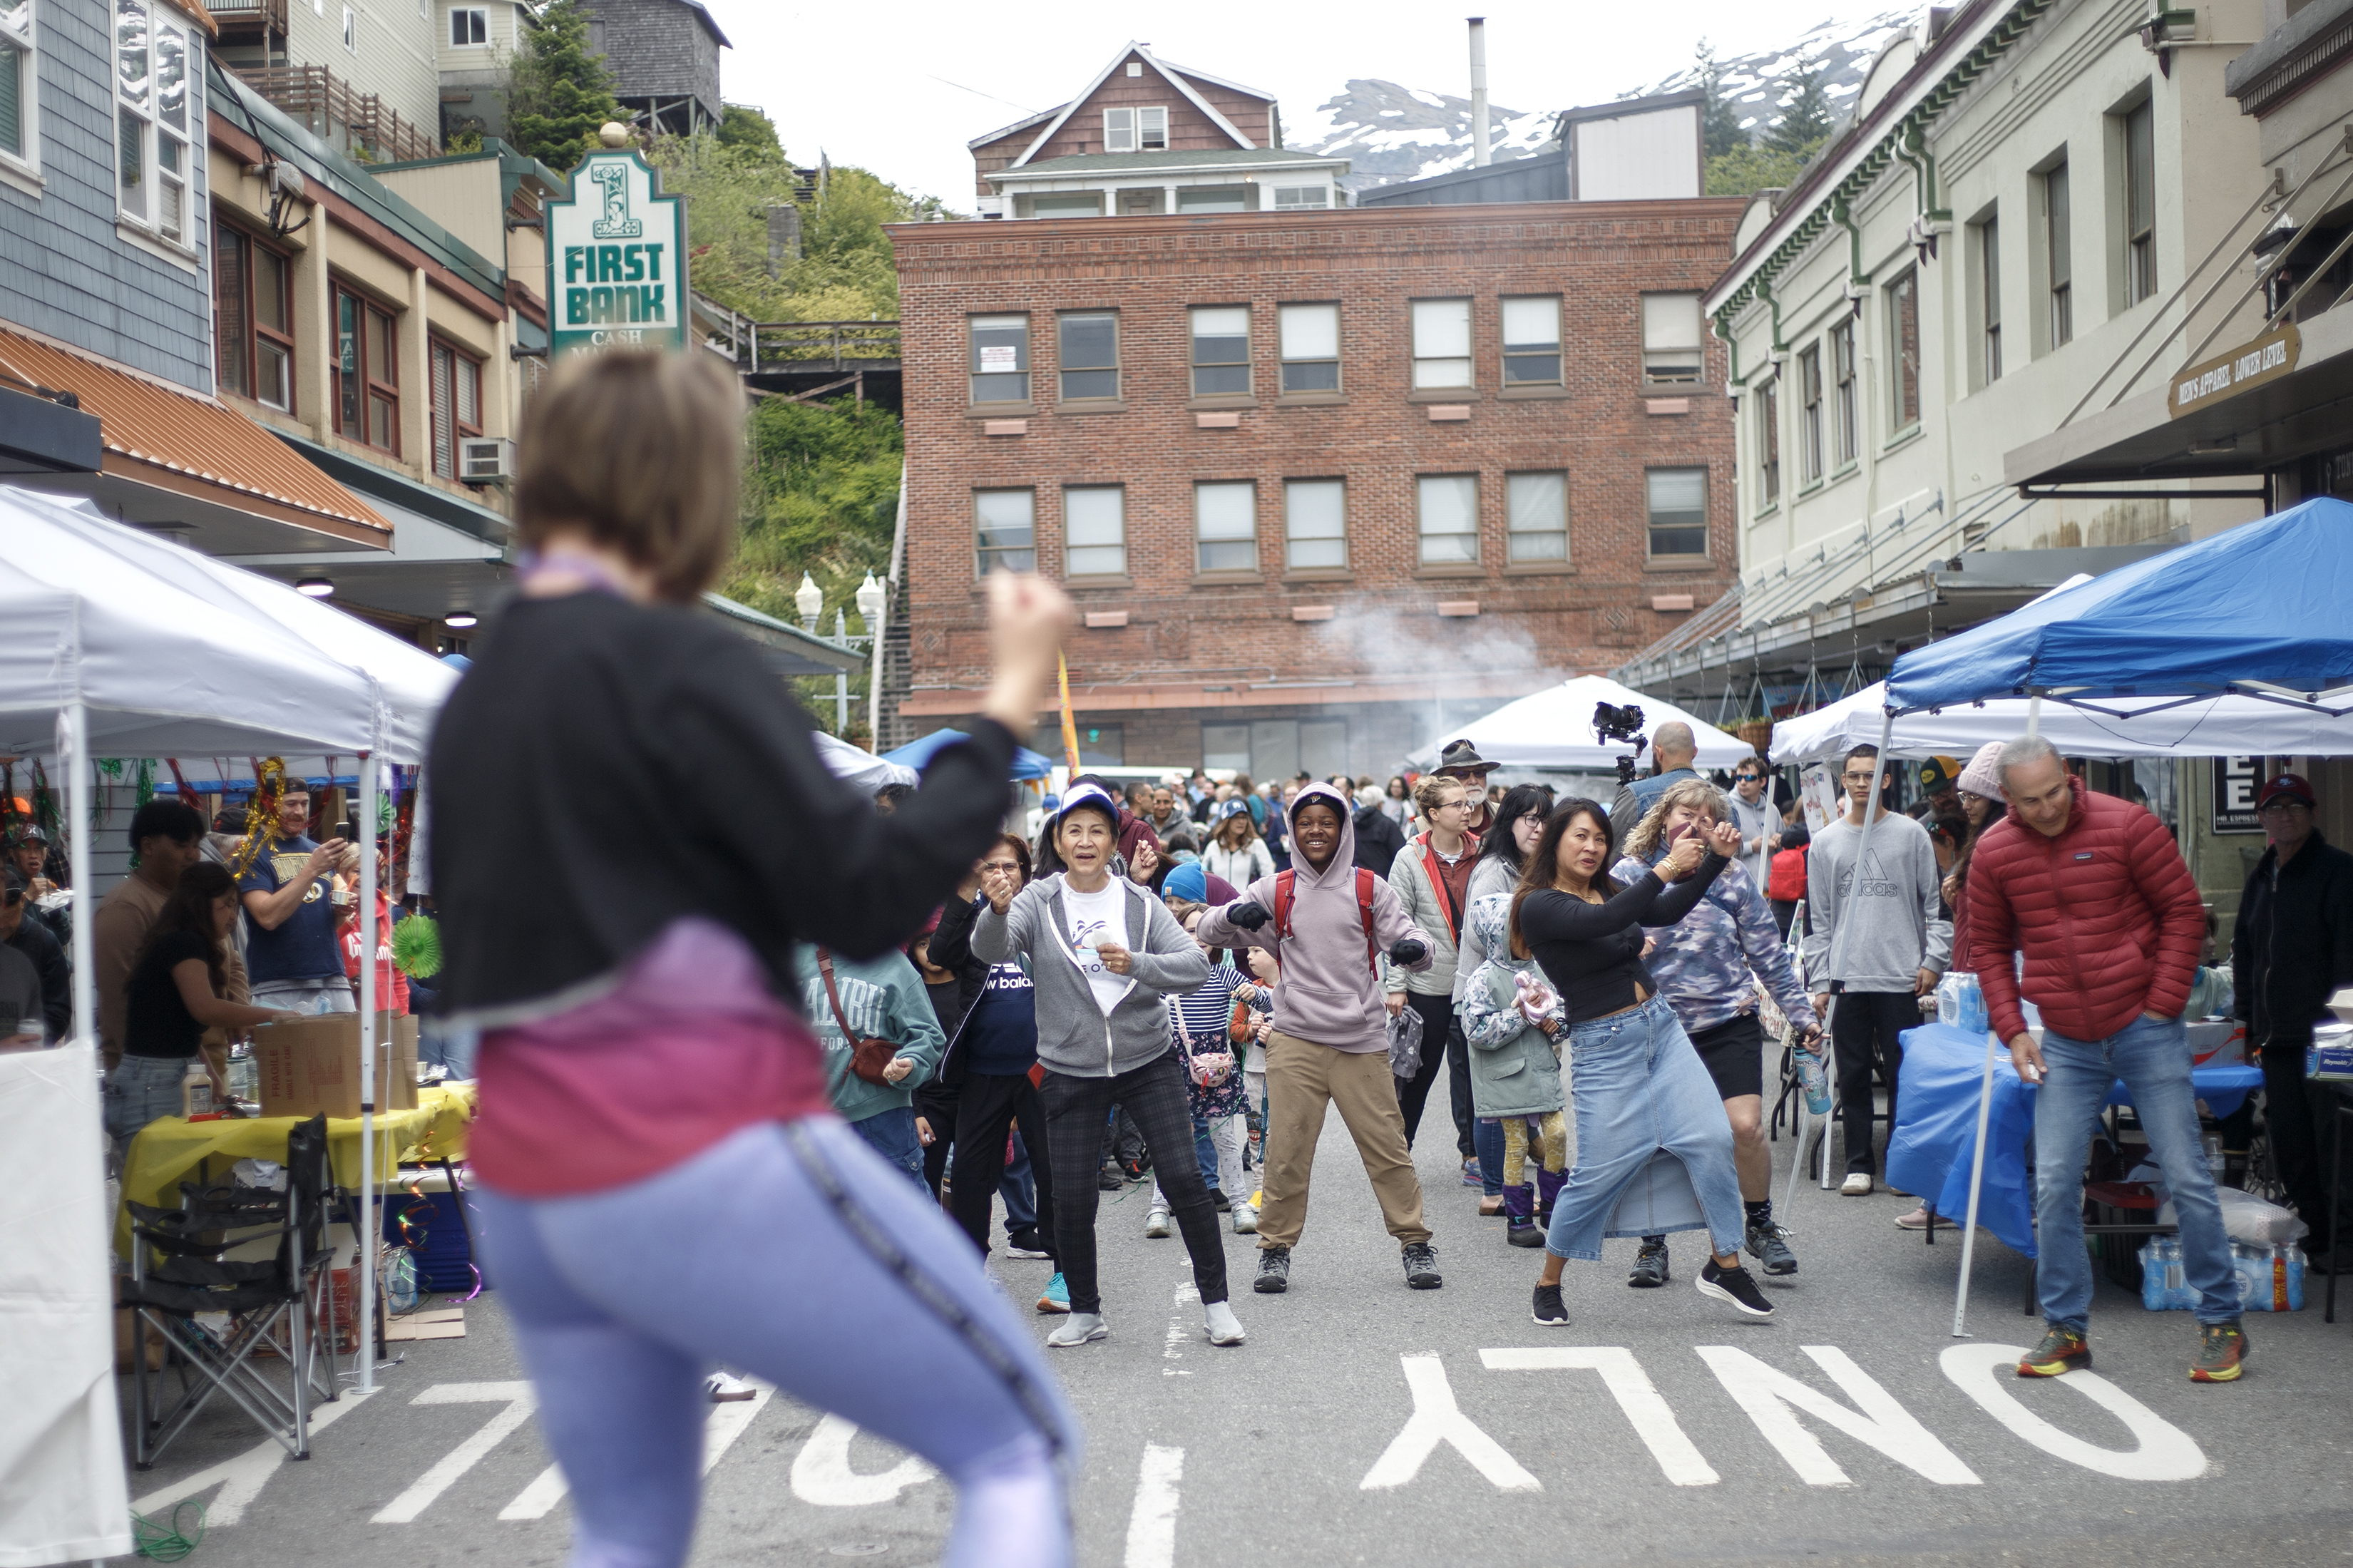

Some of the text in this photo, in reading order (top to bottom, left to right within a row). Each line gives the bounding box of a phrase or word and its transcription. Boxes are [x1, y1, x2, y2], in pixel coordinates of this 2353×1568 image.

[565, 243, 664, 284] FIRST
[566, 284, 666, 325] BANK
[591, 329, 642, 346] CASH
[2178, 339, 2287, 406] MEN'S APPAREL LOWER LEVEL
[270, 1049, 281, 1097] FRAGILE
[1359, 1342, 2210, 1492] ONLY
